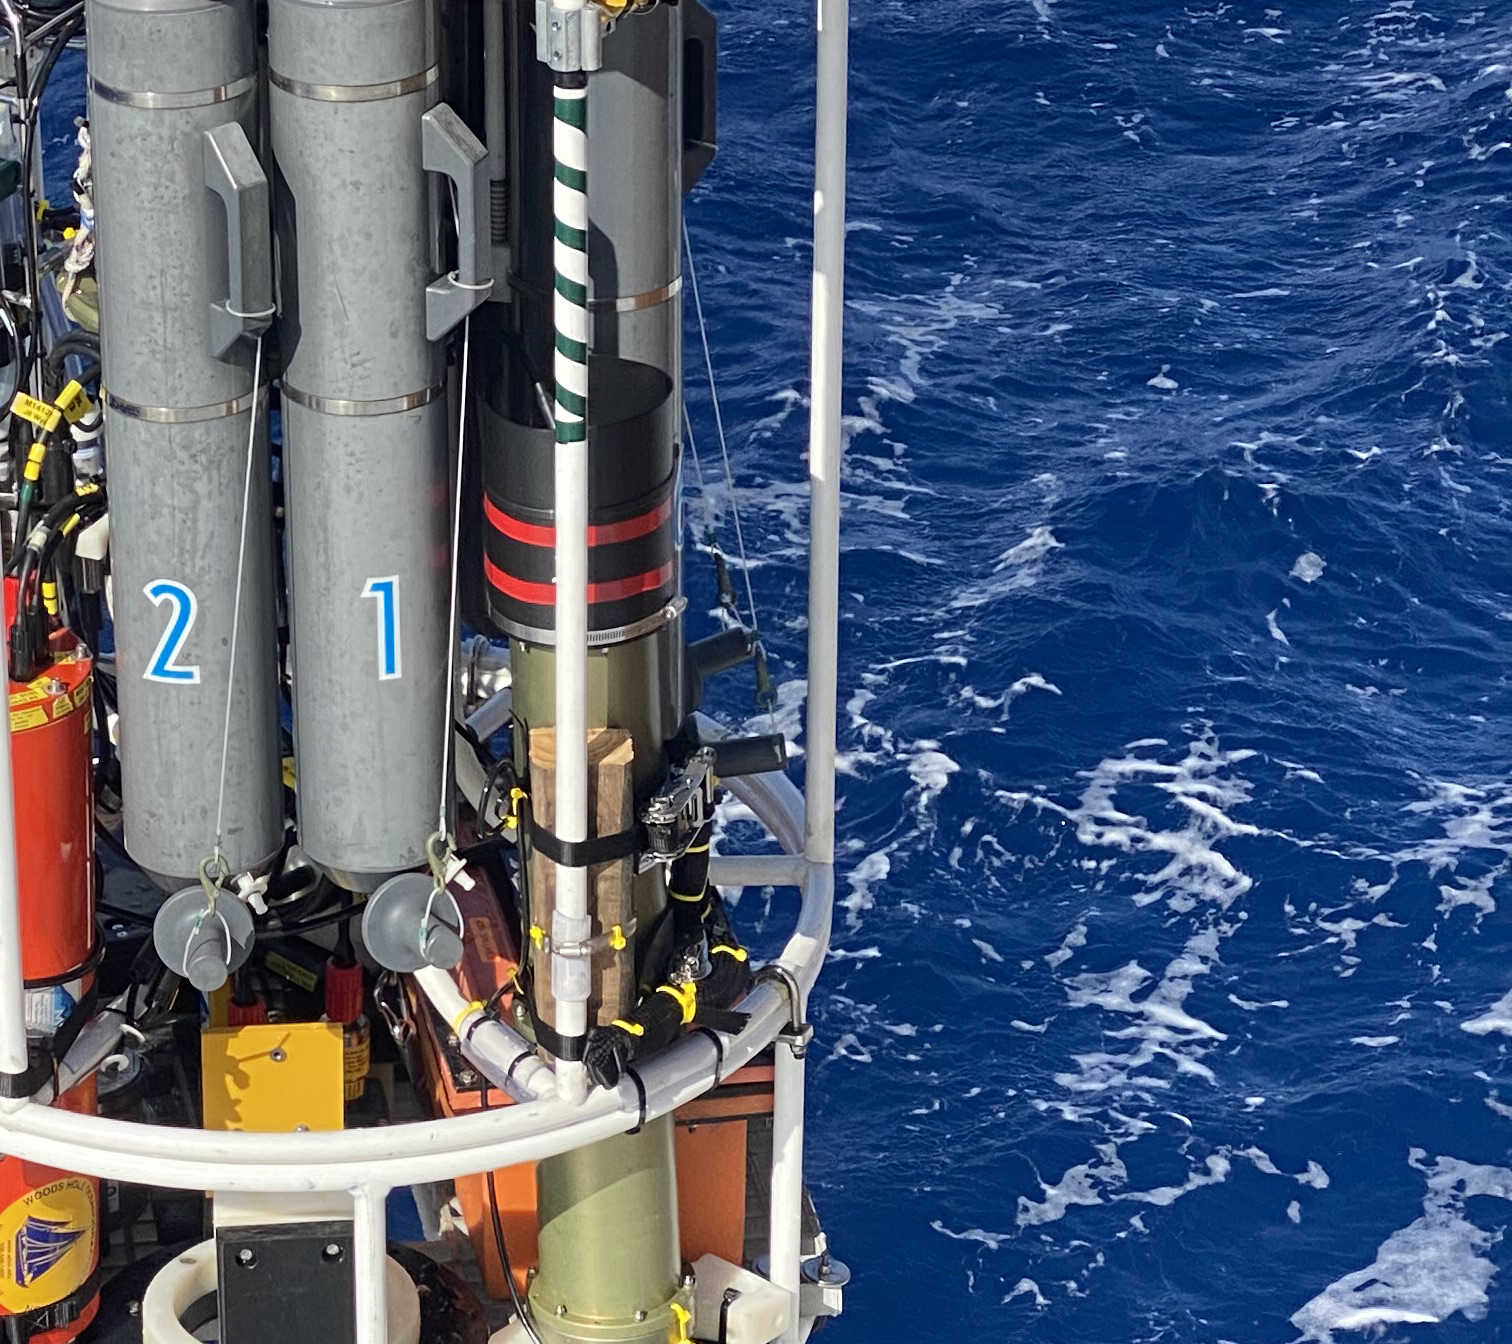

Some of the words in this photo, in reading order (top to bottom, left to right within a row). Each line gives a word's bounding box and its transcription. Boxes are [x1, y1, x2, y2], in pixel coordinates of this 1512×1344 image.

[143, 579, 200, 684] 2
[360, 574, 402, 680] 1
[23, 1181, 65, 1206] WOODS
